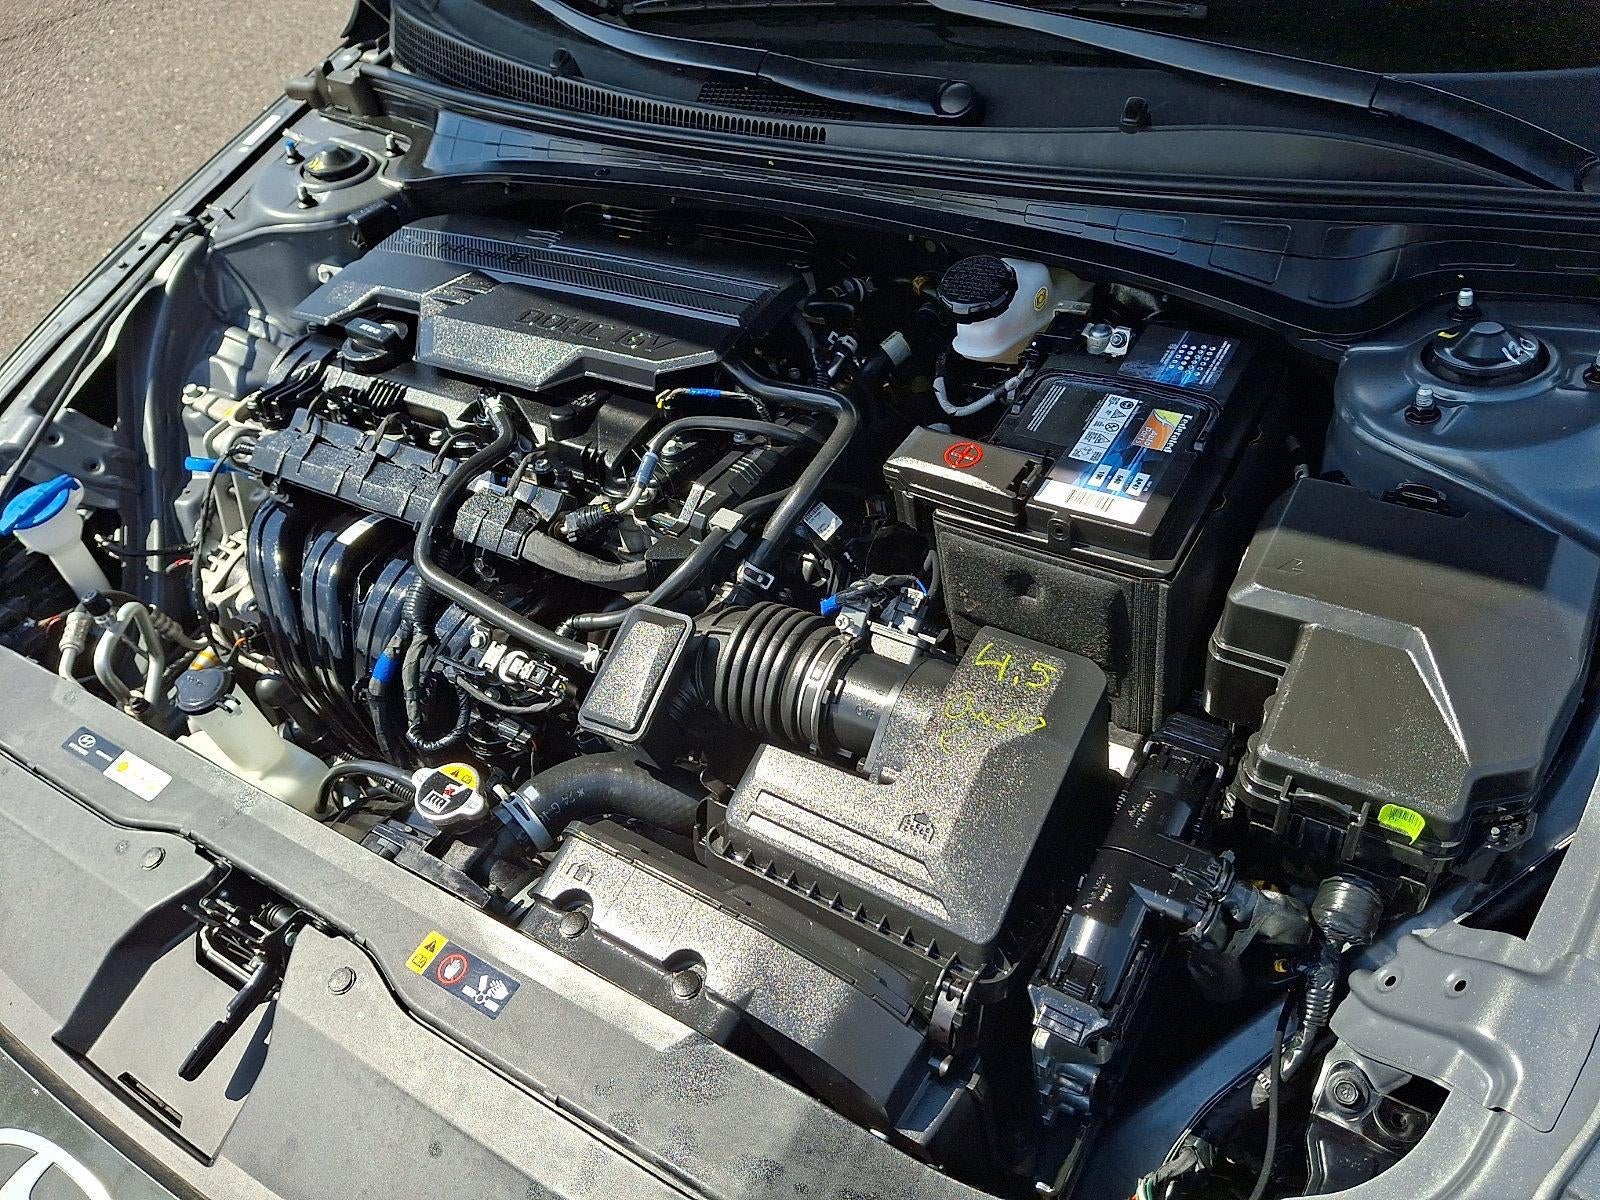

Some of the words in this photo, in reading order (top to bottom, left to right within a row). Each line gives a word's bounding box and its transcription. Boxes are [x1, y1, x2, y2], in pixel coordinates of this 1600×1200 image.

[513, 309, 602, 341] DOHC
[1134, 426, 1153, 444] Parts
[1142, 430, 1159, 447] Auto
[1162, 413, 1193, 454] Federated
[974, 642, 1058, 689] 4.5
